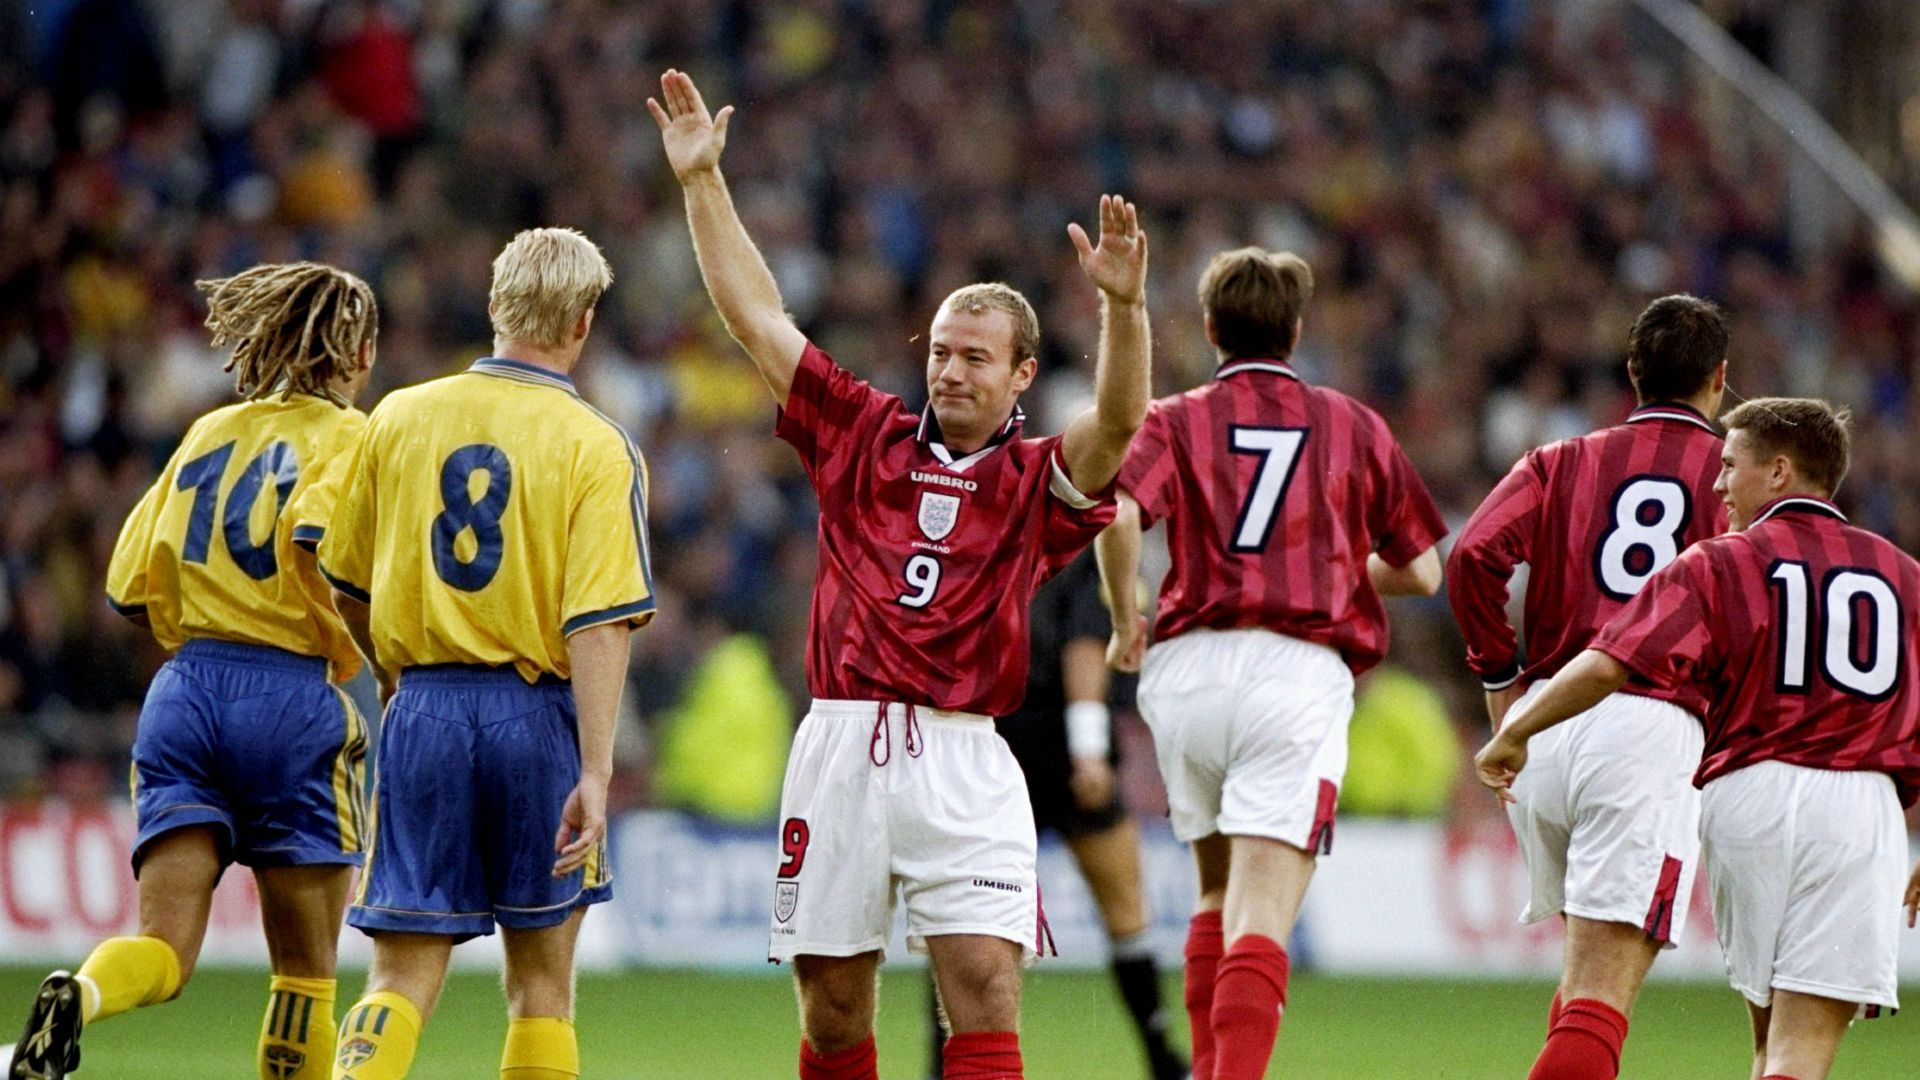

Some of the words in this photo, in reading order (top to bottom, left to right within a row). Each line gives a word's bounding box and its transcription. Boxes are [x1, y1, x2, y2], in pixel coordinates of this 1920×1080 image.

[177, 440, 299, 580] 10
[431, 443, 512, 592] 8
[911, 471, 977, 492] UMBRO
[1228, 424, 1308, 553] 7
[899, 553, 943, 608] 9
[911, 541, 951, 554] ENGLAND
[1594, 474, 1693, 602] 8
[1767, 560, 1901, 698] 10
[777, 817, 809, 879] 9
[973, 879, 1022, 893] UMBRO
